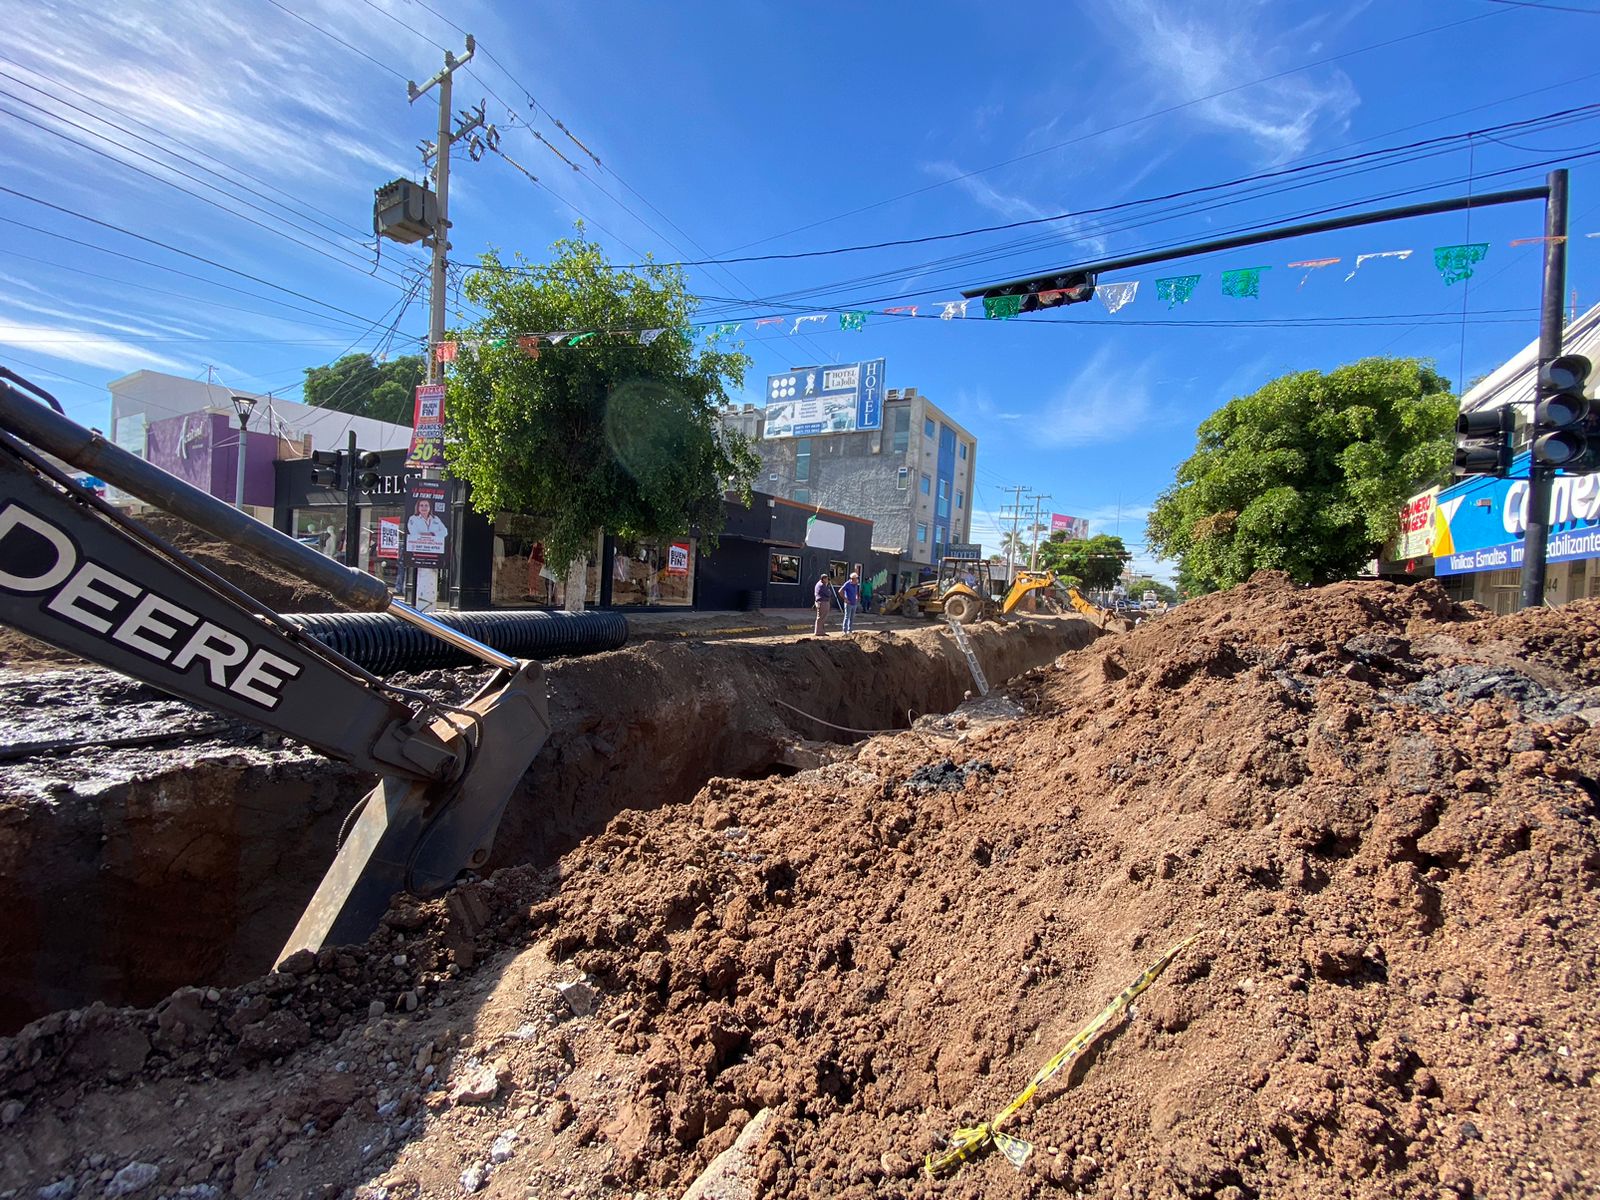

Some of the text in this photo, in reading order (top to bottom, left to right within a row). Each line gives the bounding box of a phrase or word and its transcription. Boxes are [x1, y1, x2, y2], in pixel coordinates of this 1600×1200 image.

[832, 369, 857, 378] HOTEL
[863, 362, 877, 426] HOTEL
[382, 526, 398, 537] BUEN
[382, 536, 394, 546] FIN
[670, 550, 686, 560] BUEN
[670, 558, 682, 566] FIN
[0, 503, 302, 708] DEERE
